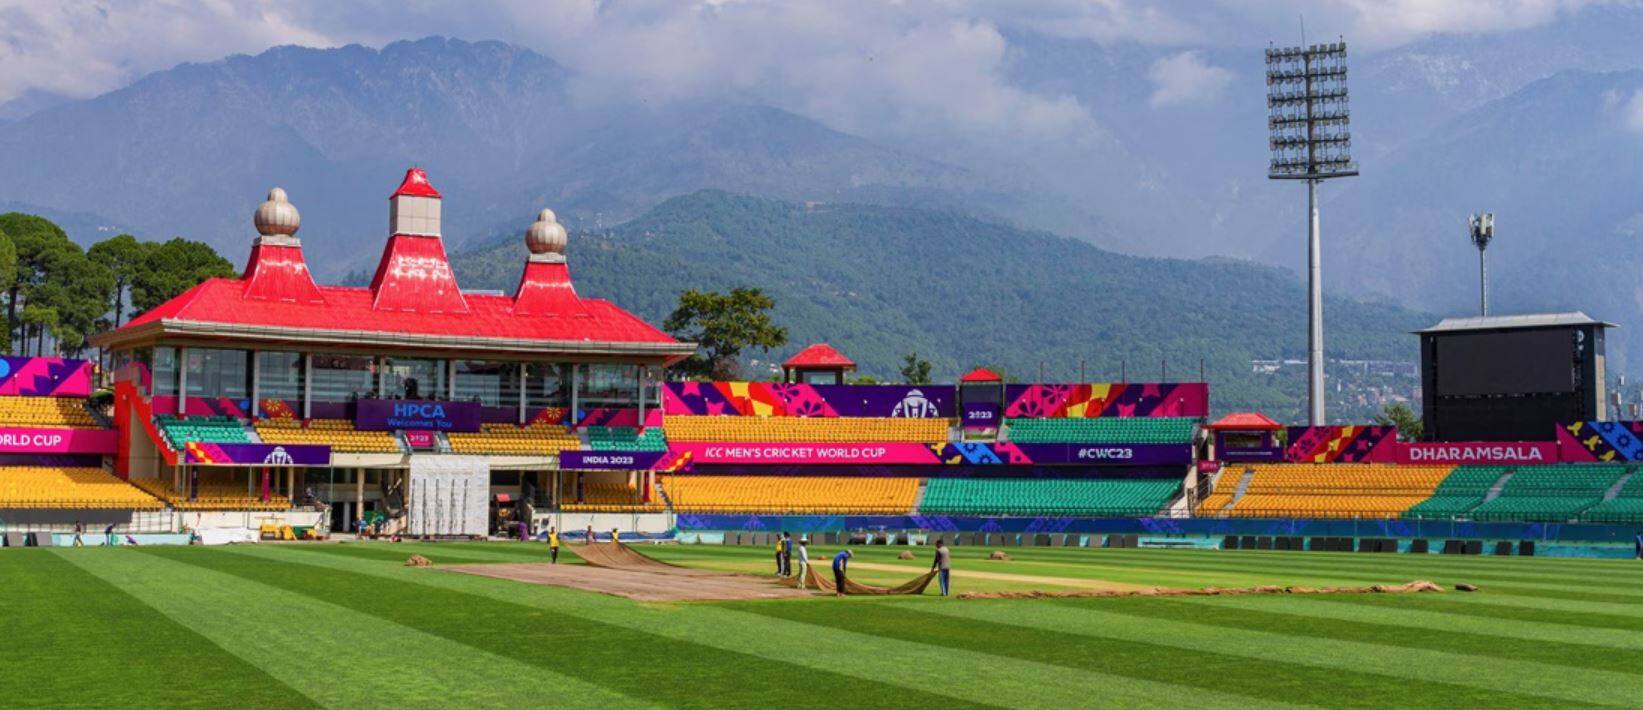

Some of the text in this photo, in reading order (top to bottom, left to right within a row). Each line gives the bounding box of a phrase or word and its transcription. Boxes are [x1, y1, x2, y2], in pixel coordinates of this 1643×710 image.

[394, 403, 446, 418] HPCA
[33, 434, 62, 447] CUP
[705, 447, 886, 458] ICC MEN'S CRICKET WORLD CUP
[1078, 448, 1132, 459] #CWC23
[1410, 447, 1543, 460] DHARAMSALA
[582, 456, 609, 464] INDIA
